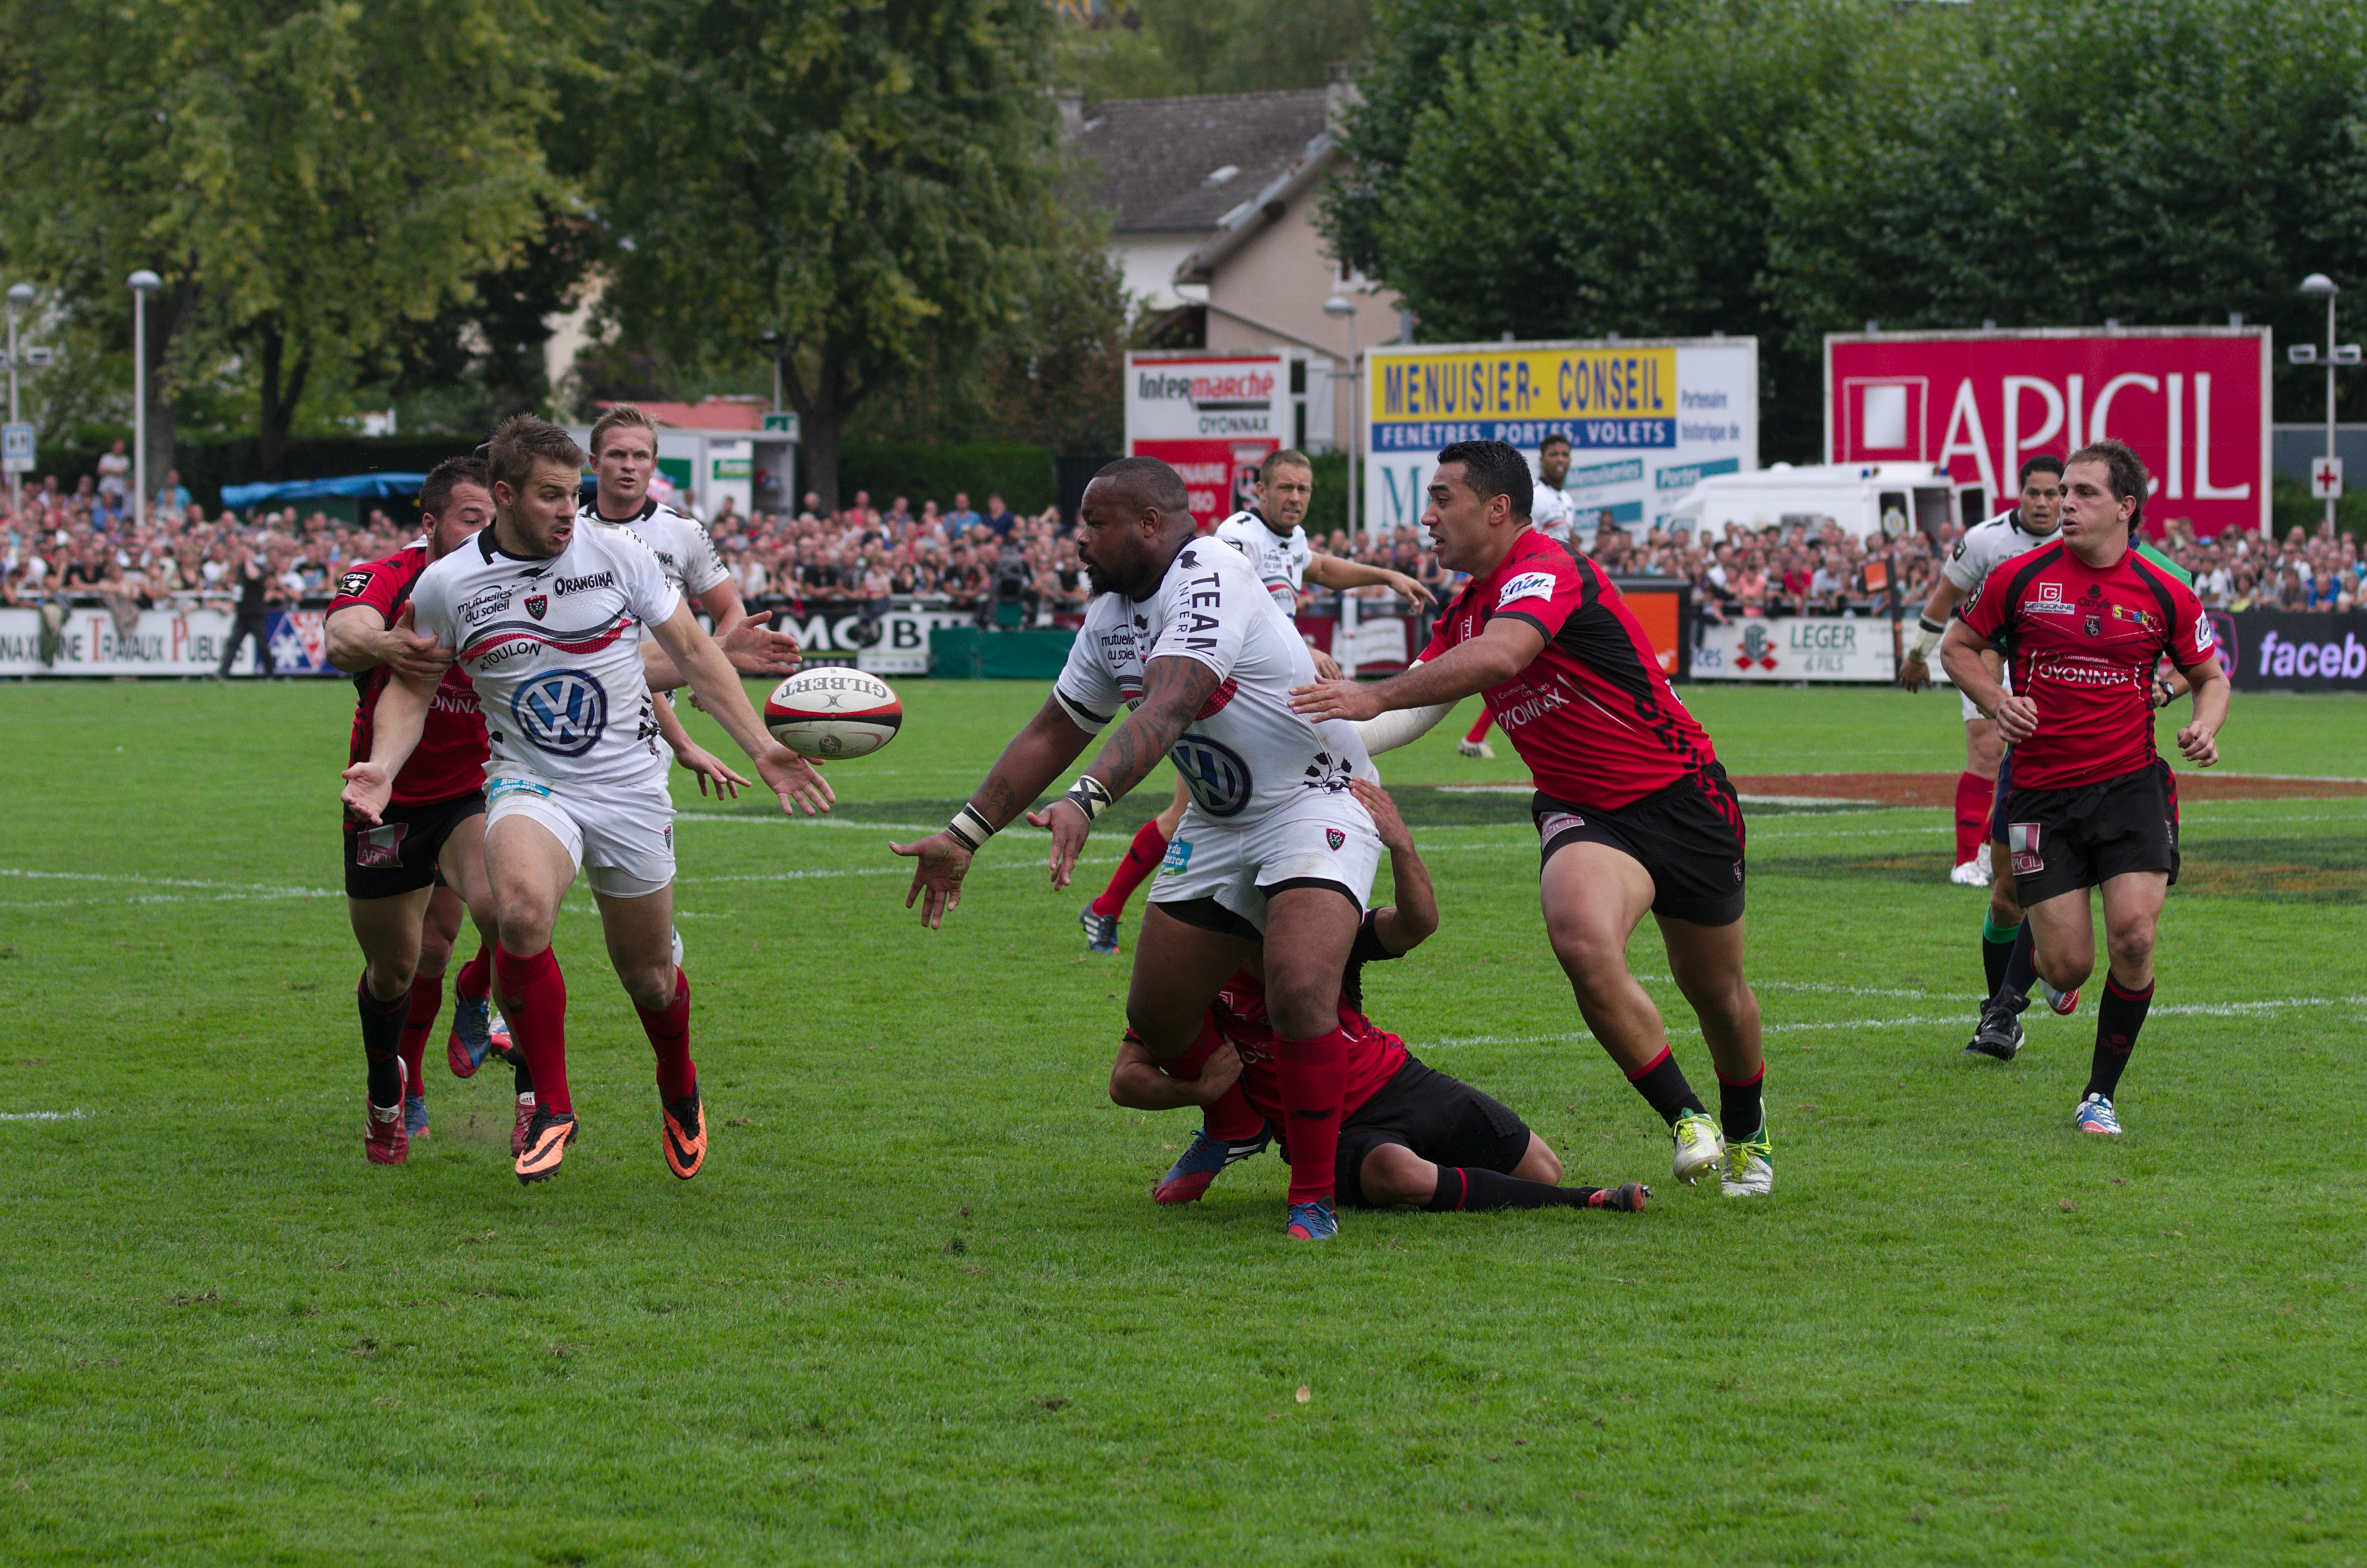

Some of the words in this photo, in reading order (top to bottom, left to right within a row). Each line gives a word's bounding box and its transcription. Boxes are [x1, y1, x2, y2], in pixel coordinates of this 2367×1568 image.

[1140, 371, 1274, 400] Intermarché
[1558, 358, 1663, 411] CONSEIL
[1682, 389, 1727, 409] Partenaire
[1199, 417, 1269, 434] OYONNAX
[1587, 421, 1666, 443] VOLETS
[1682, 421, 1725, 444] historique
[1729, 421, 1740, 440] de
[1938, 372, 2250, 500] APICIL
[554, 571, 615, 597] ORANGINA
[457, 589, 512, 614] mutuelles
[466, 611, 478, 622] du
[481, 600, 509, 617] soleil
[1791, 625, 1855, 649] LEGER
[483, 642, 542, 667] TOULON
[1818, 656, 1844, 671] FILS
[781, 676, 888, 700] GILBERT
[2011, 855, 2041, 871] PICIL
